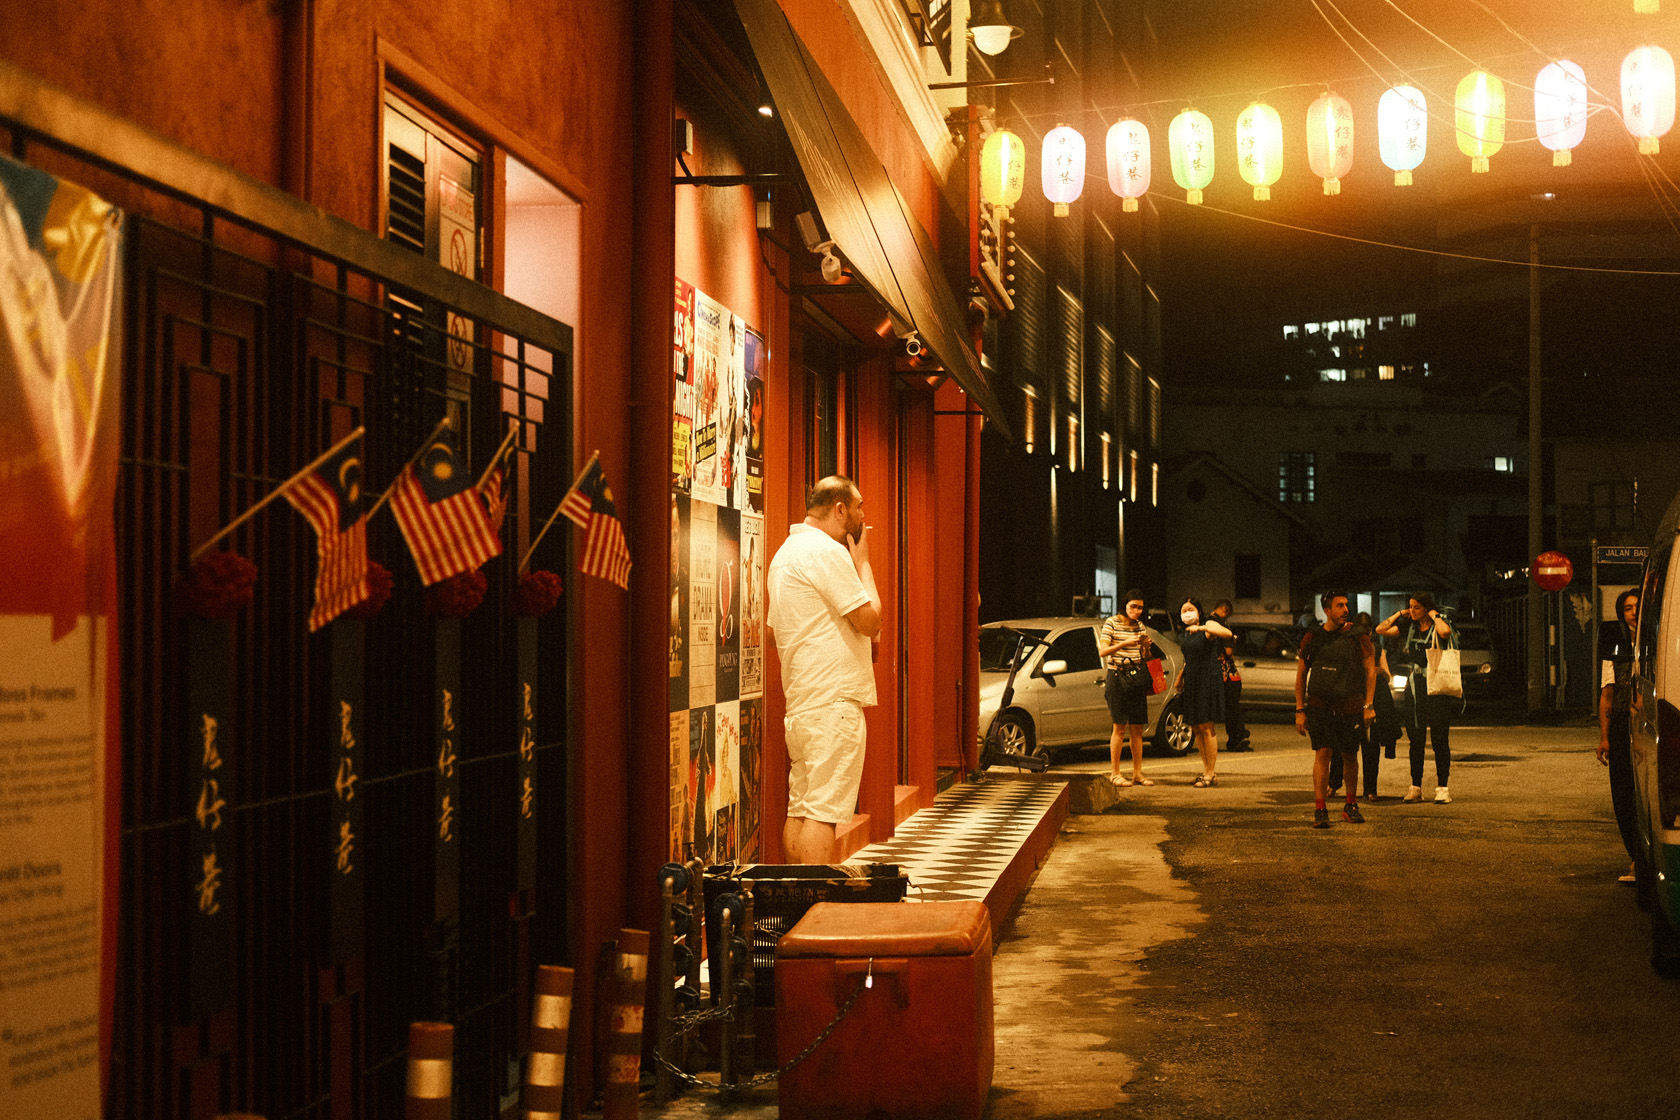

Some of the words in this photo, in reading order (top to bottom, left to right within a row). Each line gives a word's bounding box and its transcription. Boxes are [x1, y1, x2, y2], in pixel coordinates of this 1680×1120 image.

[1335, 105, 1352, 160] 鬼仔巷
[1605, 549, 1630, 557] JALAN
